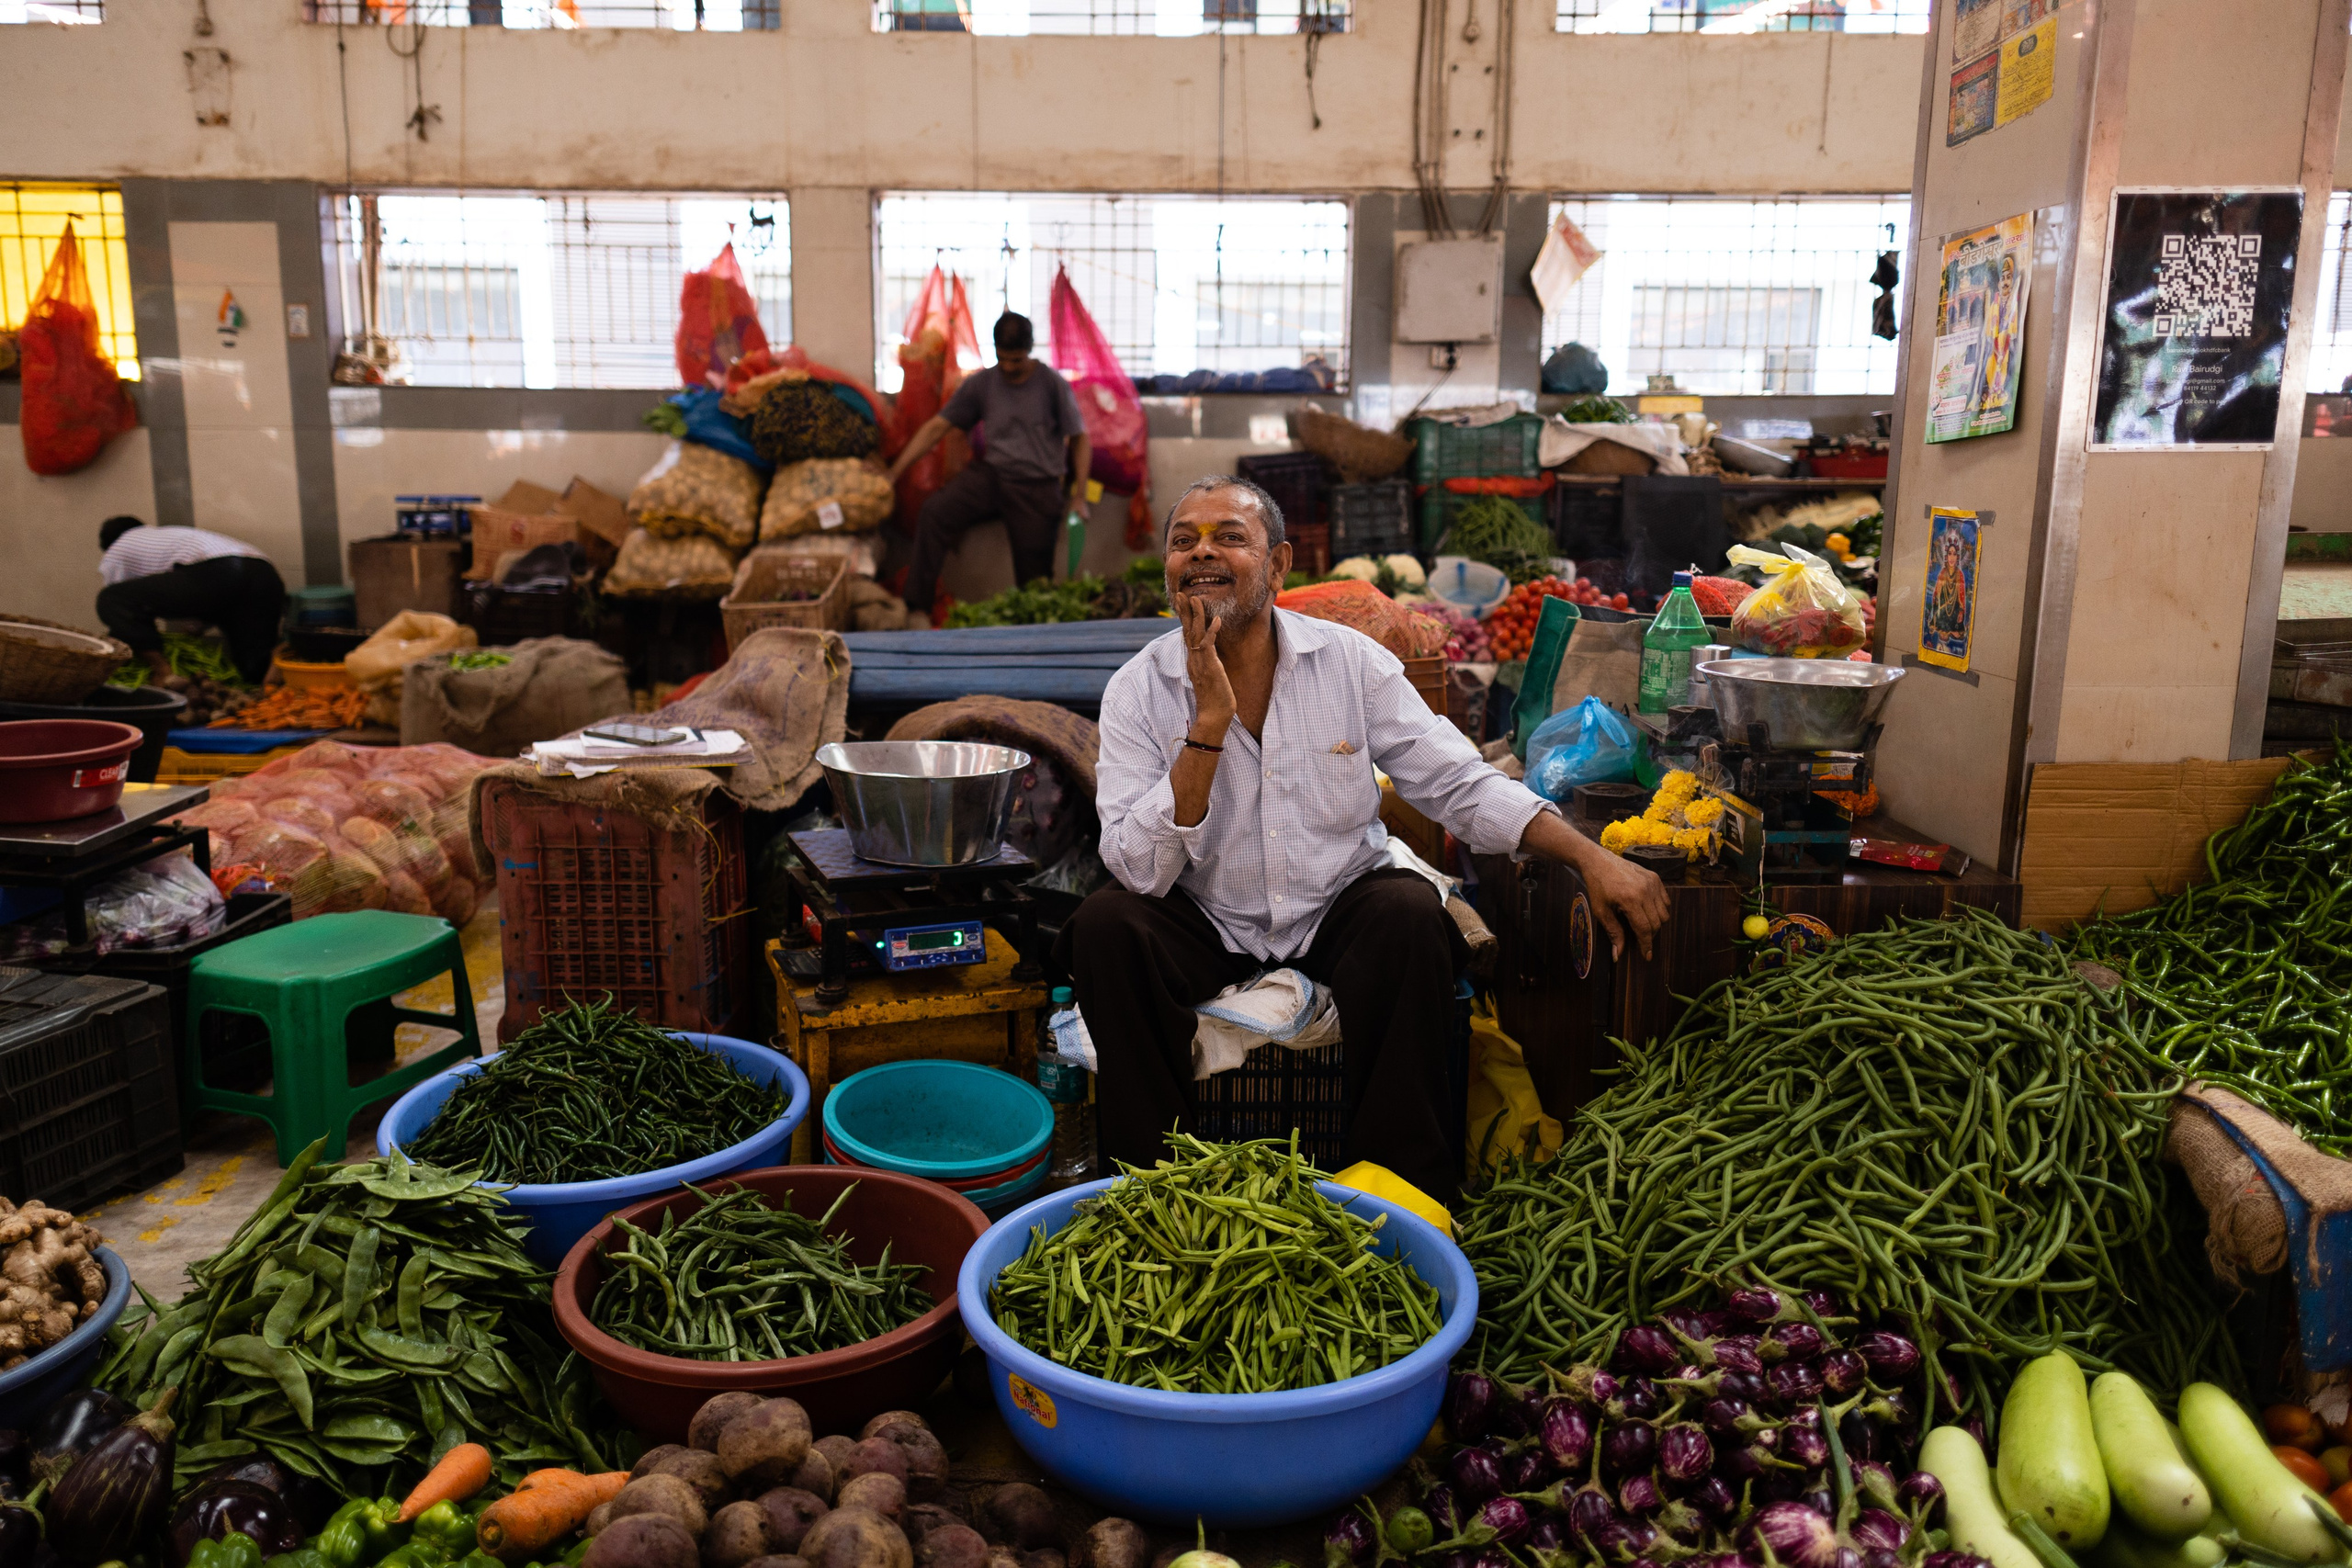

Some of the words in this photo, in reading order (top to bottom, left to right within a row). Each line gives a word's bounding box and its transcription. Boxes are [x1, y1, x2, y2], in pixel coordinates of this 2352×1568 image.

[2171, 365, 2188, 373] Ravi
[2190, 366, 2222, 374] Bairudgi
[953, 931, 963, 946] 3
[1013, 1389, 1051, 1421] National
